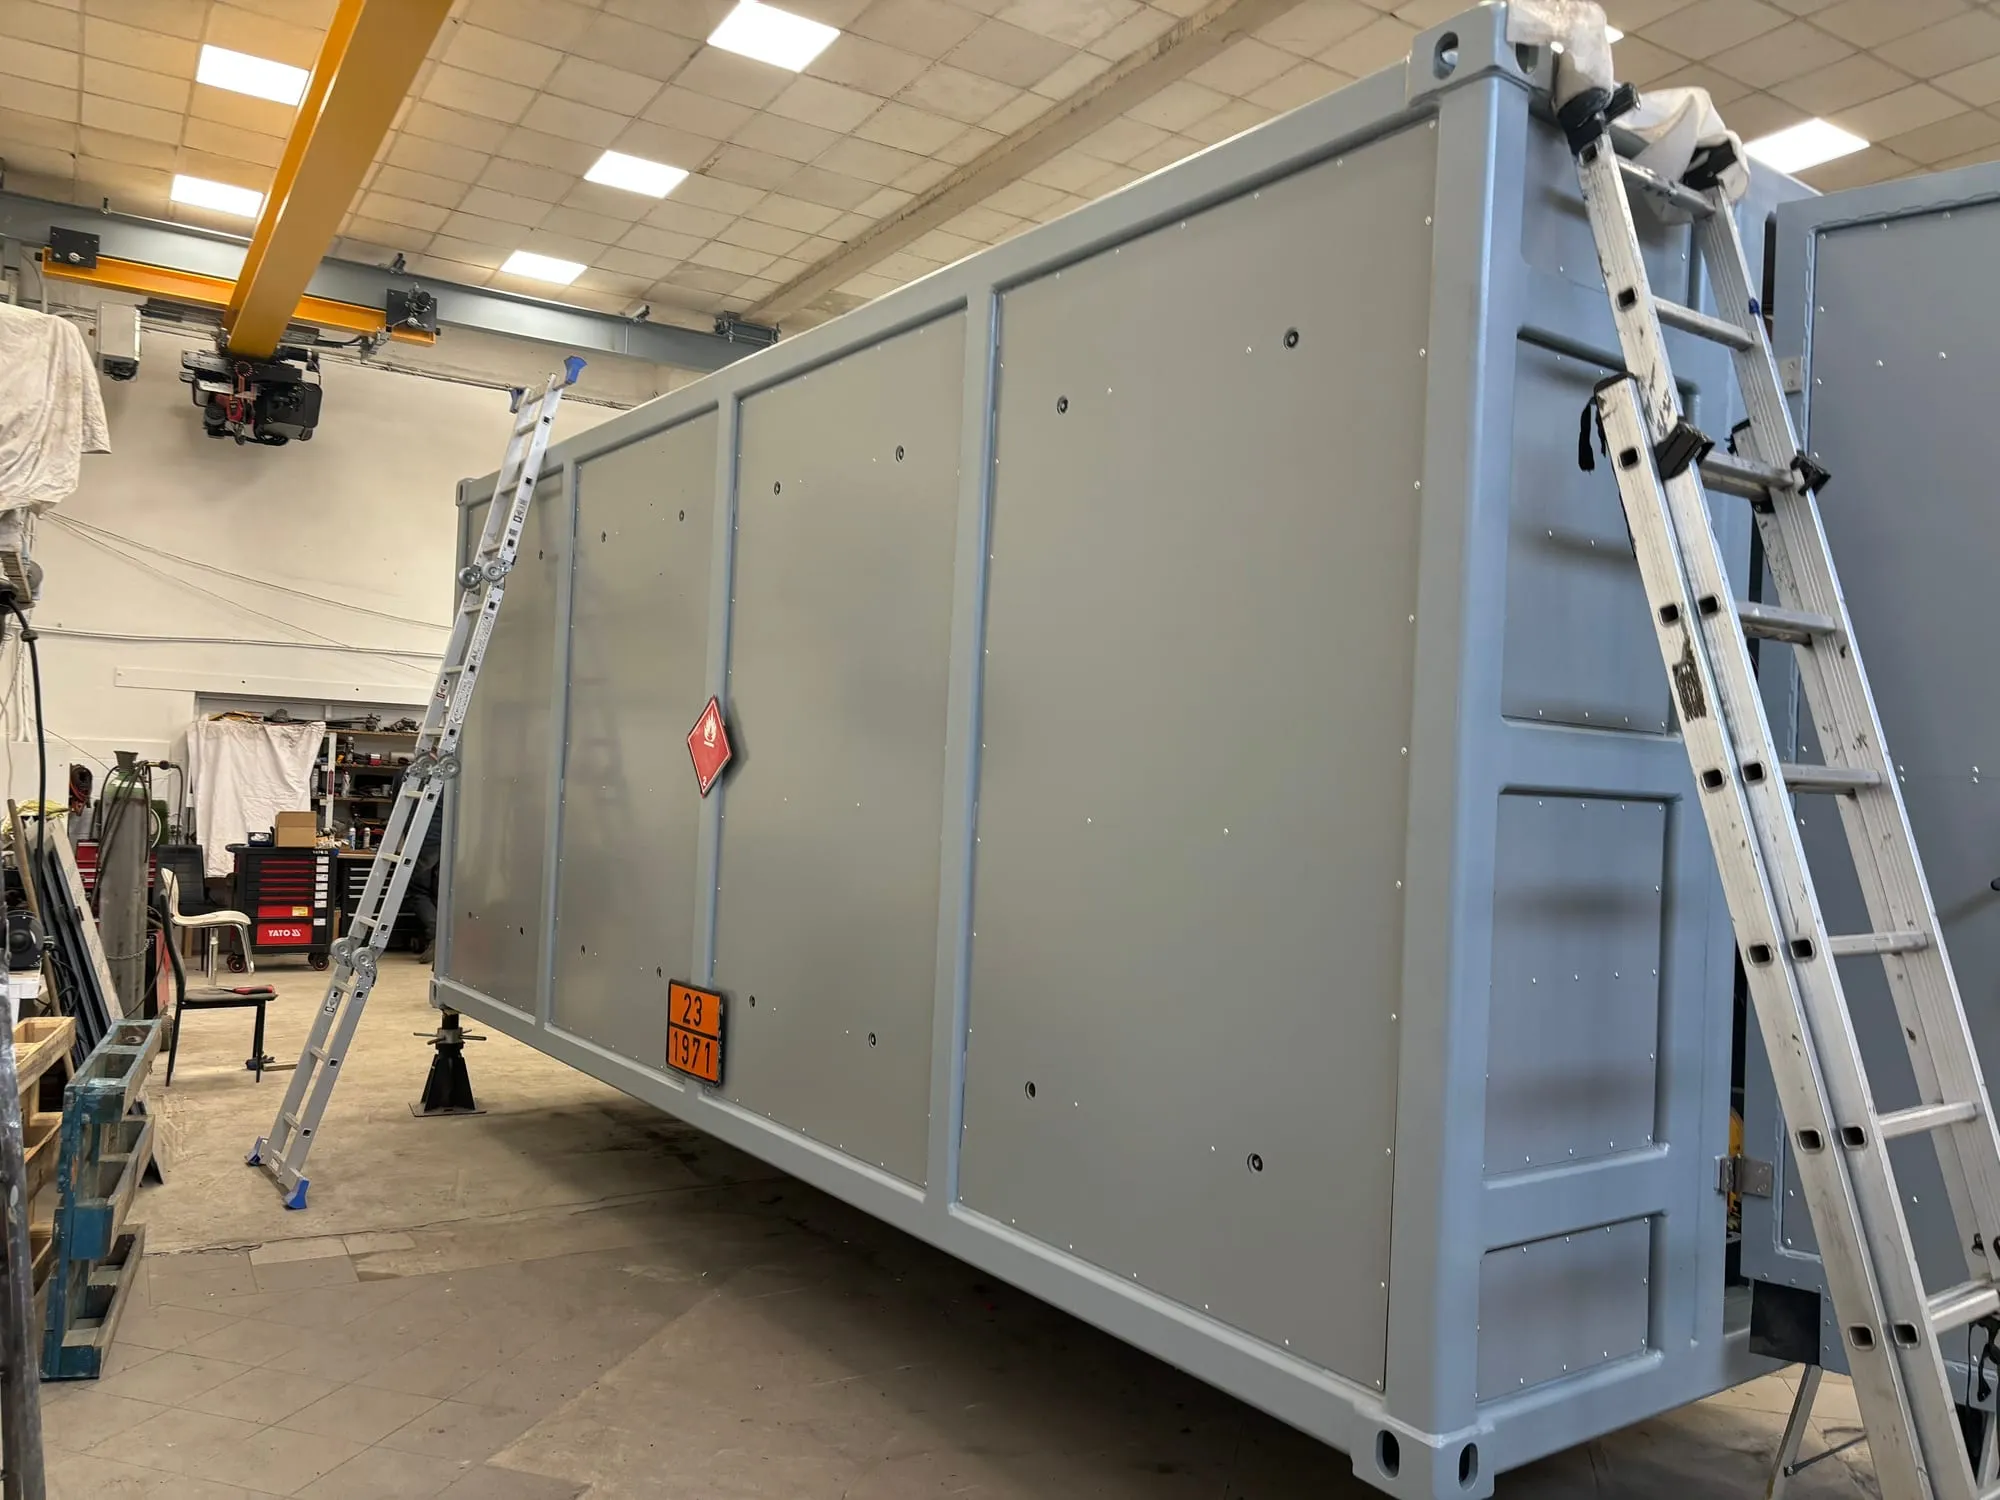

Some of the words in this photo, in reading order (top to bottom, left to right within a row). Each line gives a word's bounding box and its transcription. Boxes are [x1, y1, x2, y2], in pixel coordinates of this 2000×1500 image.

[268, 929, 291, 937] YATO
[683, 993, 702, 1027] 23
[674, 1030, 710, 1073] 1971
